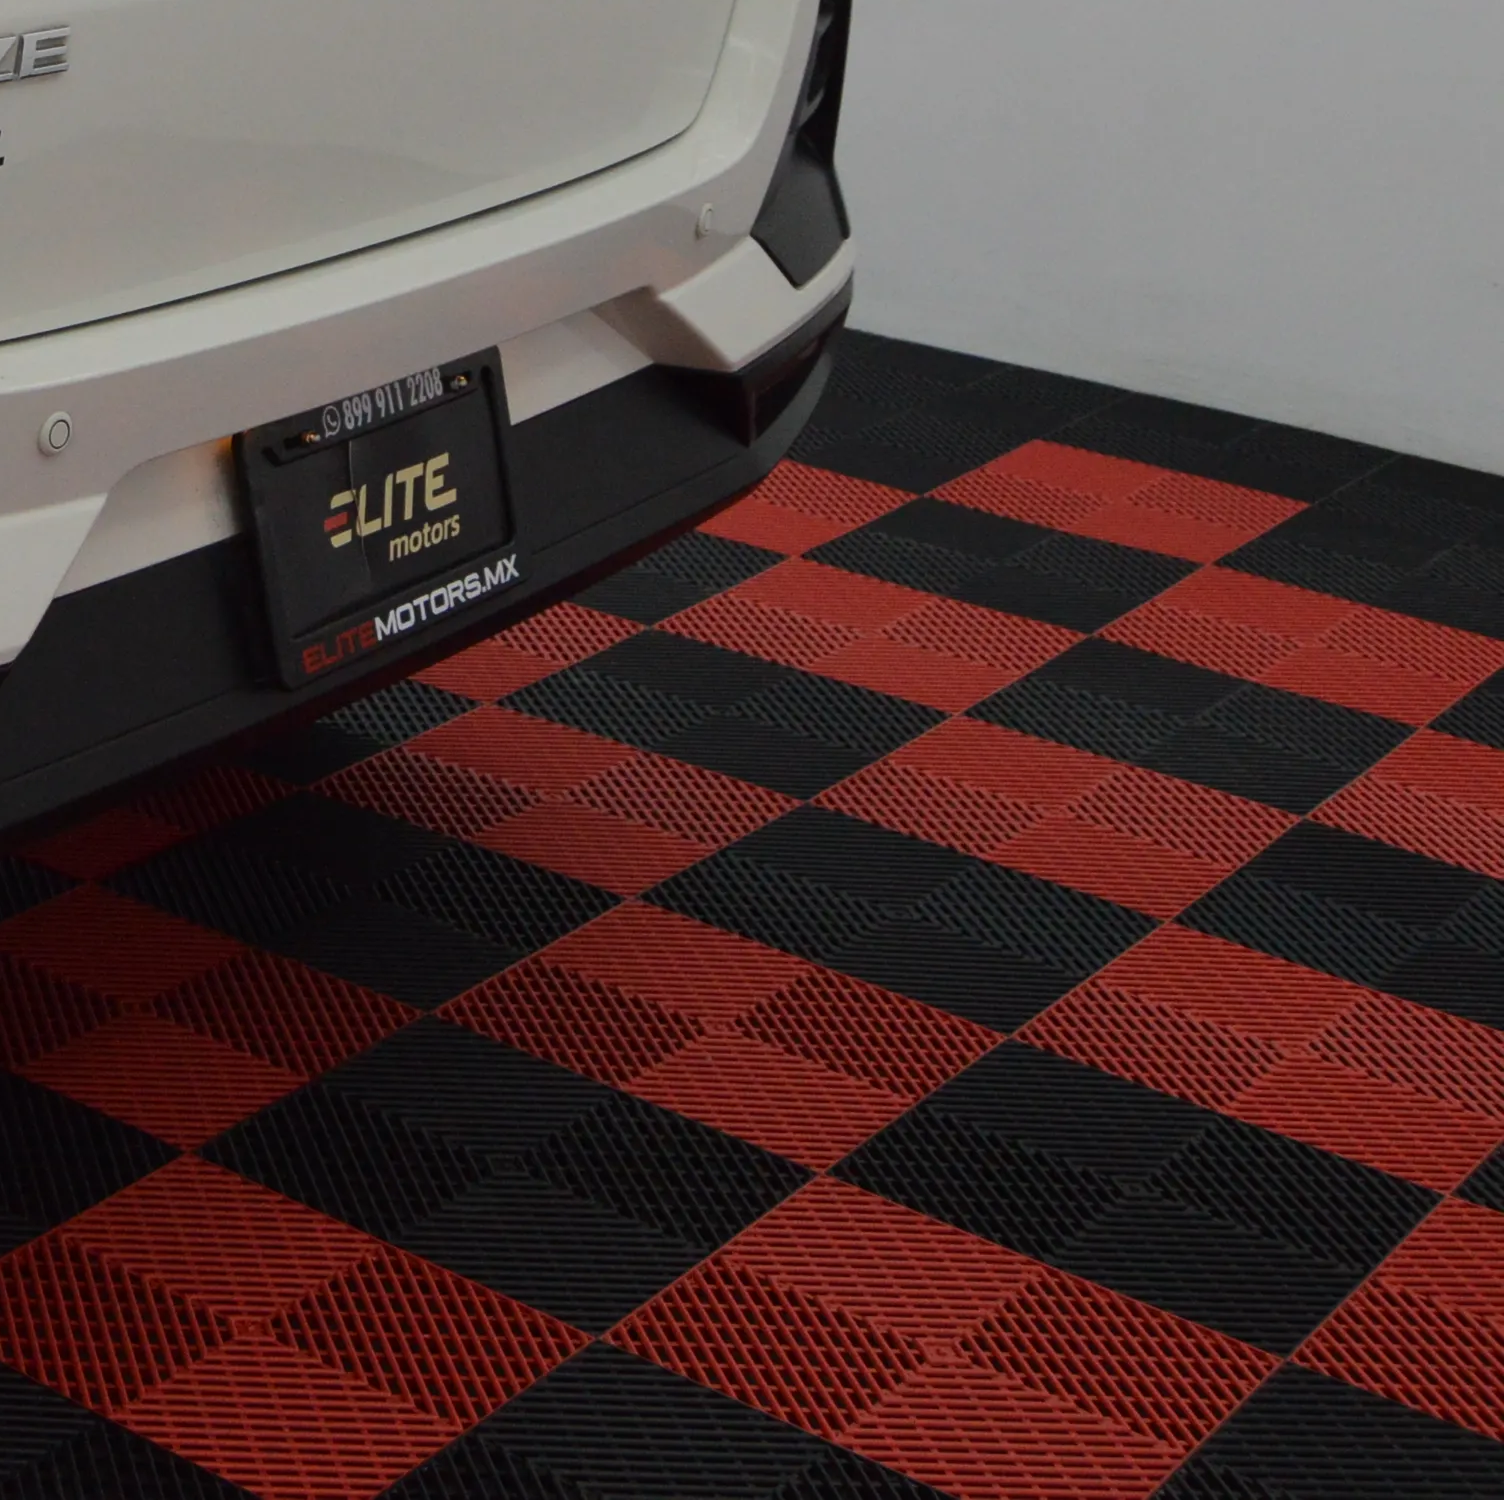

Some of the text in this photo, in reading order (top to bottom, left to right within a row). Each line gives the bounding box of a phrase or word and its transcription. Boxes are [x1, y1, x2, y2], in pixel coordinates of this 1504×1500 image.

[343, 368, 443, 430] 899 911 2208
[324, 452, 457, 548] ELITE
[389, 513, 460, 561] motors
[303, 554, 520, 674] ELITEMOTORS.MX
